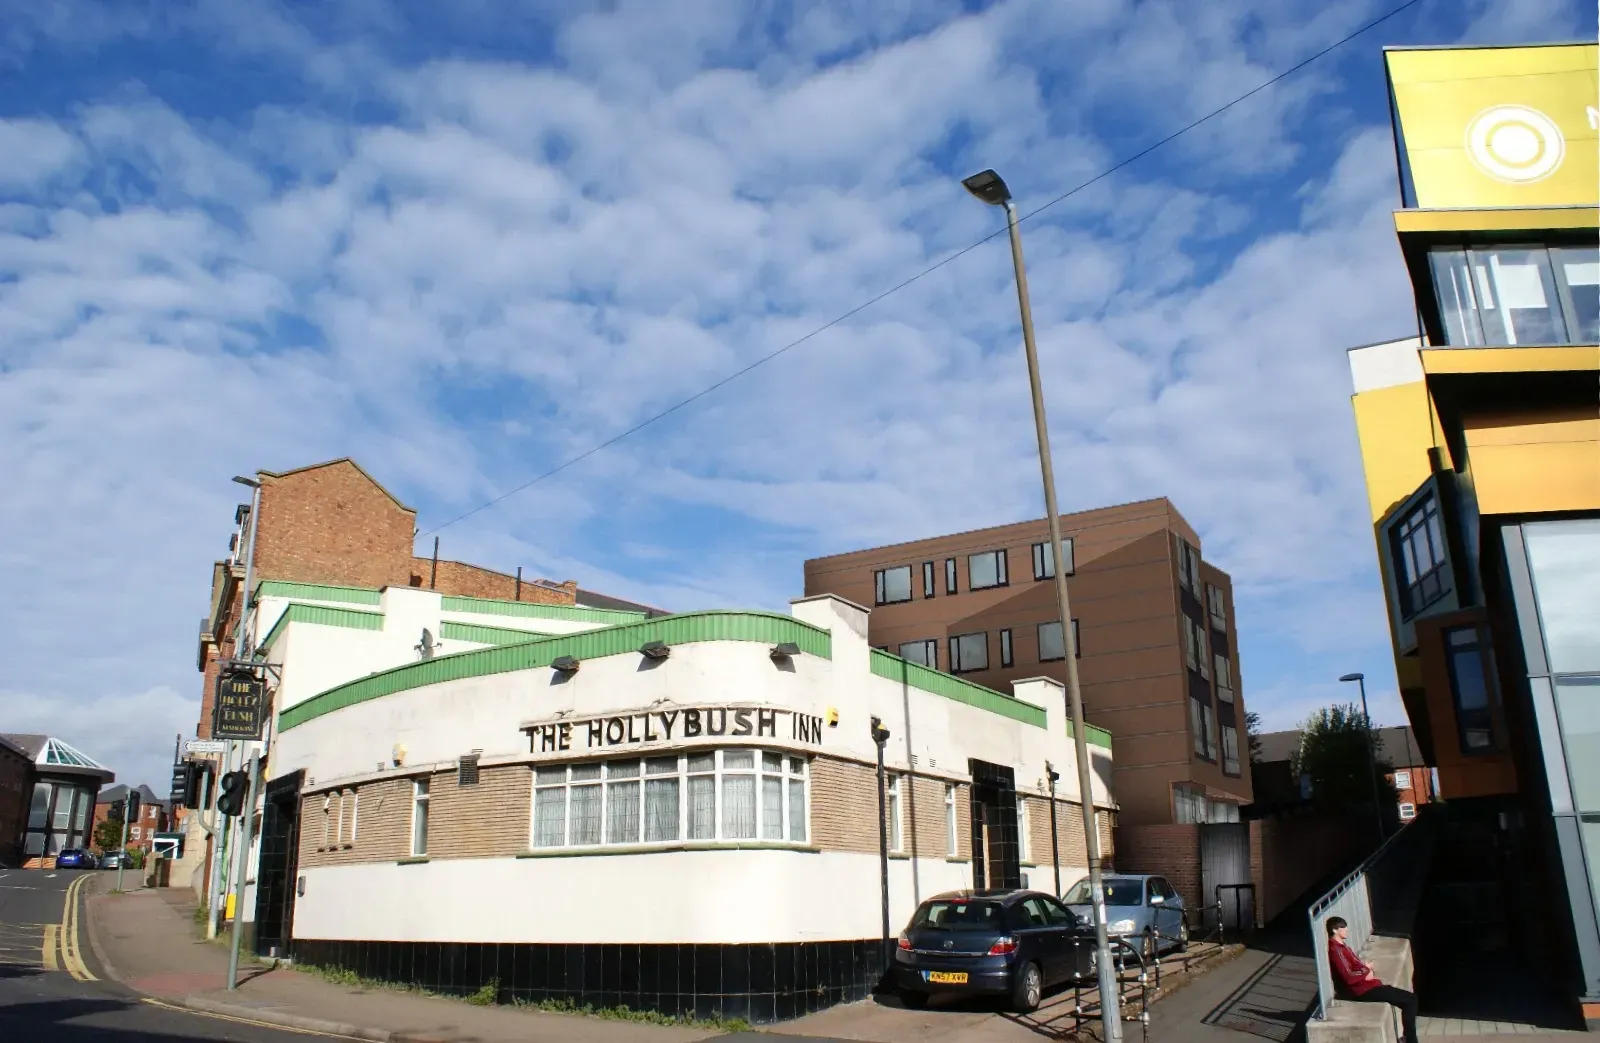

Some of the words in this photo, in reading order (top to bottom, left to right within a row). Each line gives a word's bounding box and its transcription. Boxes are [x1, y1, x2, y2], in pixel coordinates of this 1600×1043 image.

[232, 683, 252, 693] THE
[224, 710, 254, 722] BUSH
[525, 722, 572, 753] THE
[588, 707, 776, 747] HOLLYBUSH
[792, 711, 823, 745] INN
[931, 972, 950, 981] KN57
